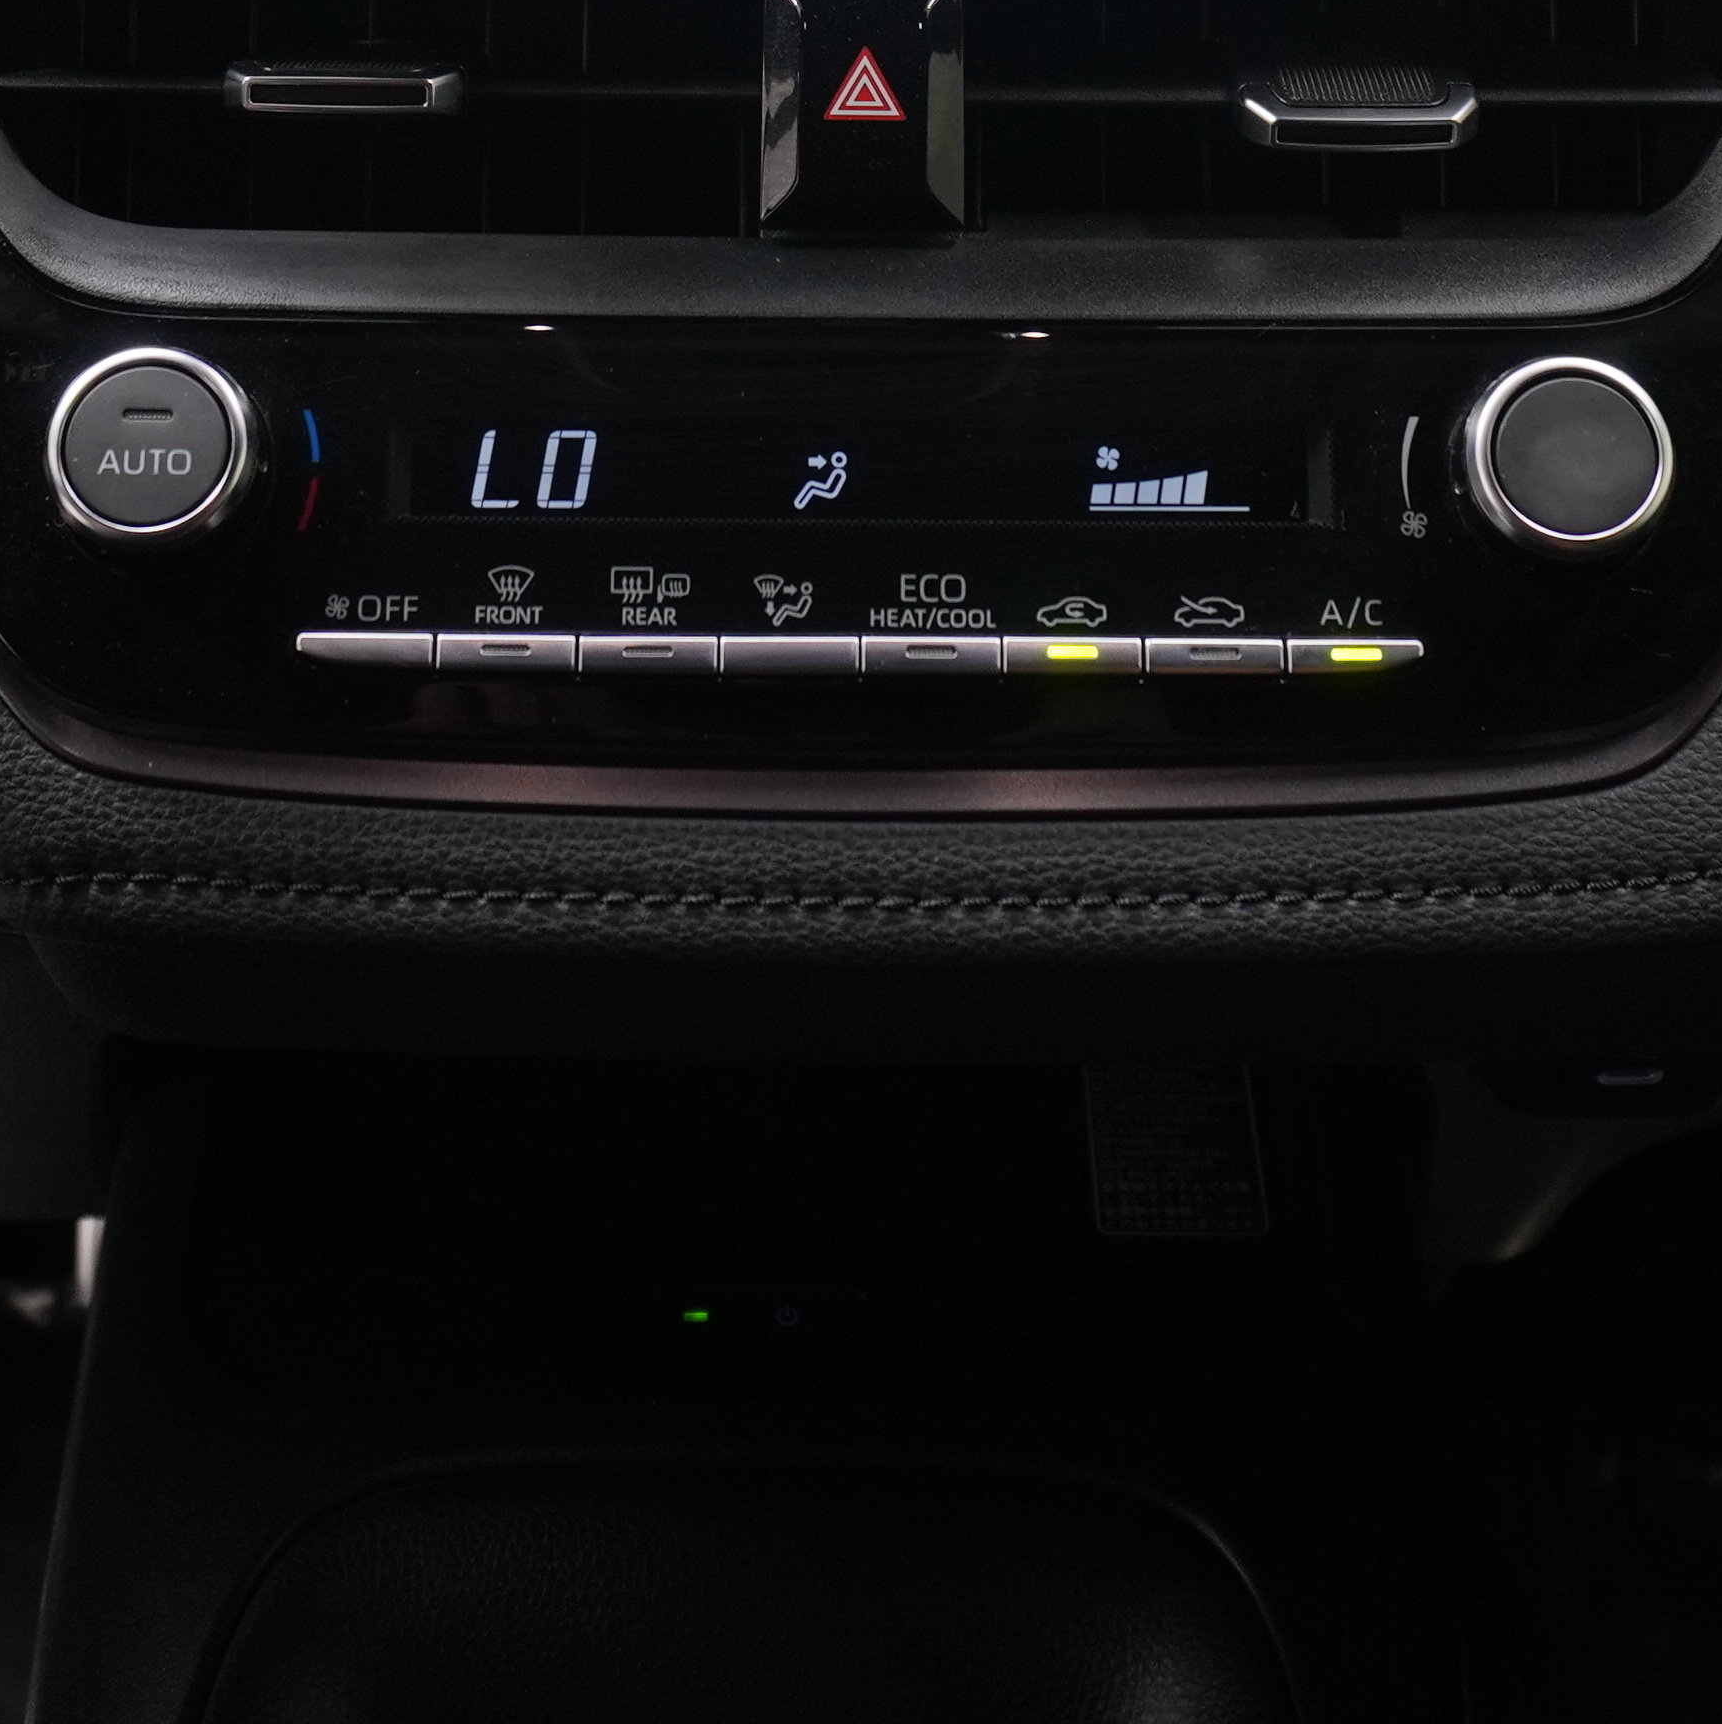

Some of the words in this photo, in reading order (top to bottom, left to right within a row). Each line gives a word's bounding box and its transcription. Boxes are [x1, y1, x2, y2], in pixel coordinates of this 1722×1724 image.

[96, 448, 193, 476] AUTO
[470, 428, 598, 510] LO
[898, 573, 967, 605] ECO
[358, 594, 419, 624] OFF
[475, 605, 544, 627] FRONT
[621, 605, 677, 627] REAR
[869, 608, 997, 630] HEAT/COOL
[1320, 598, 1383, 629] A/C
